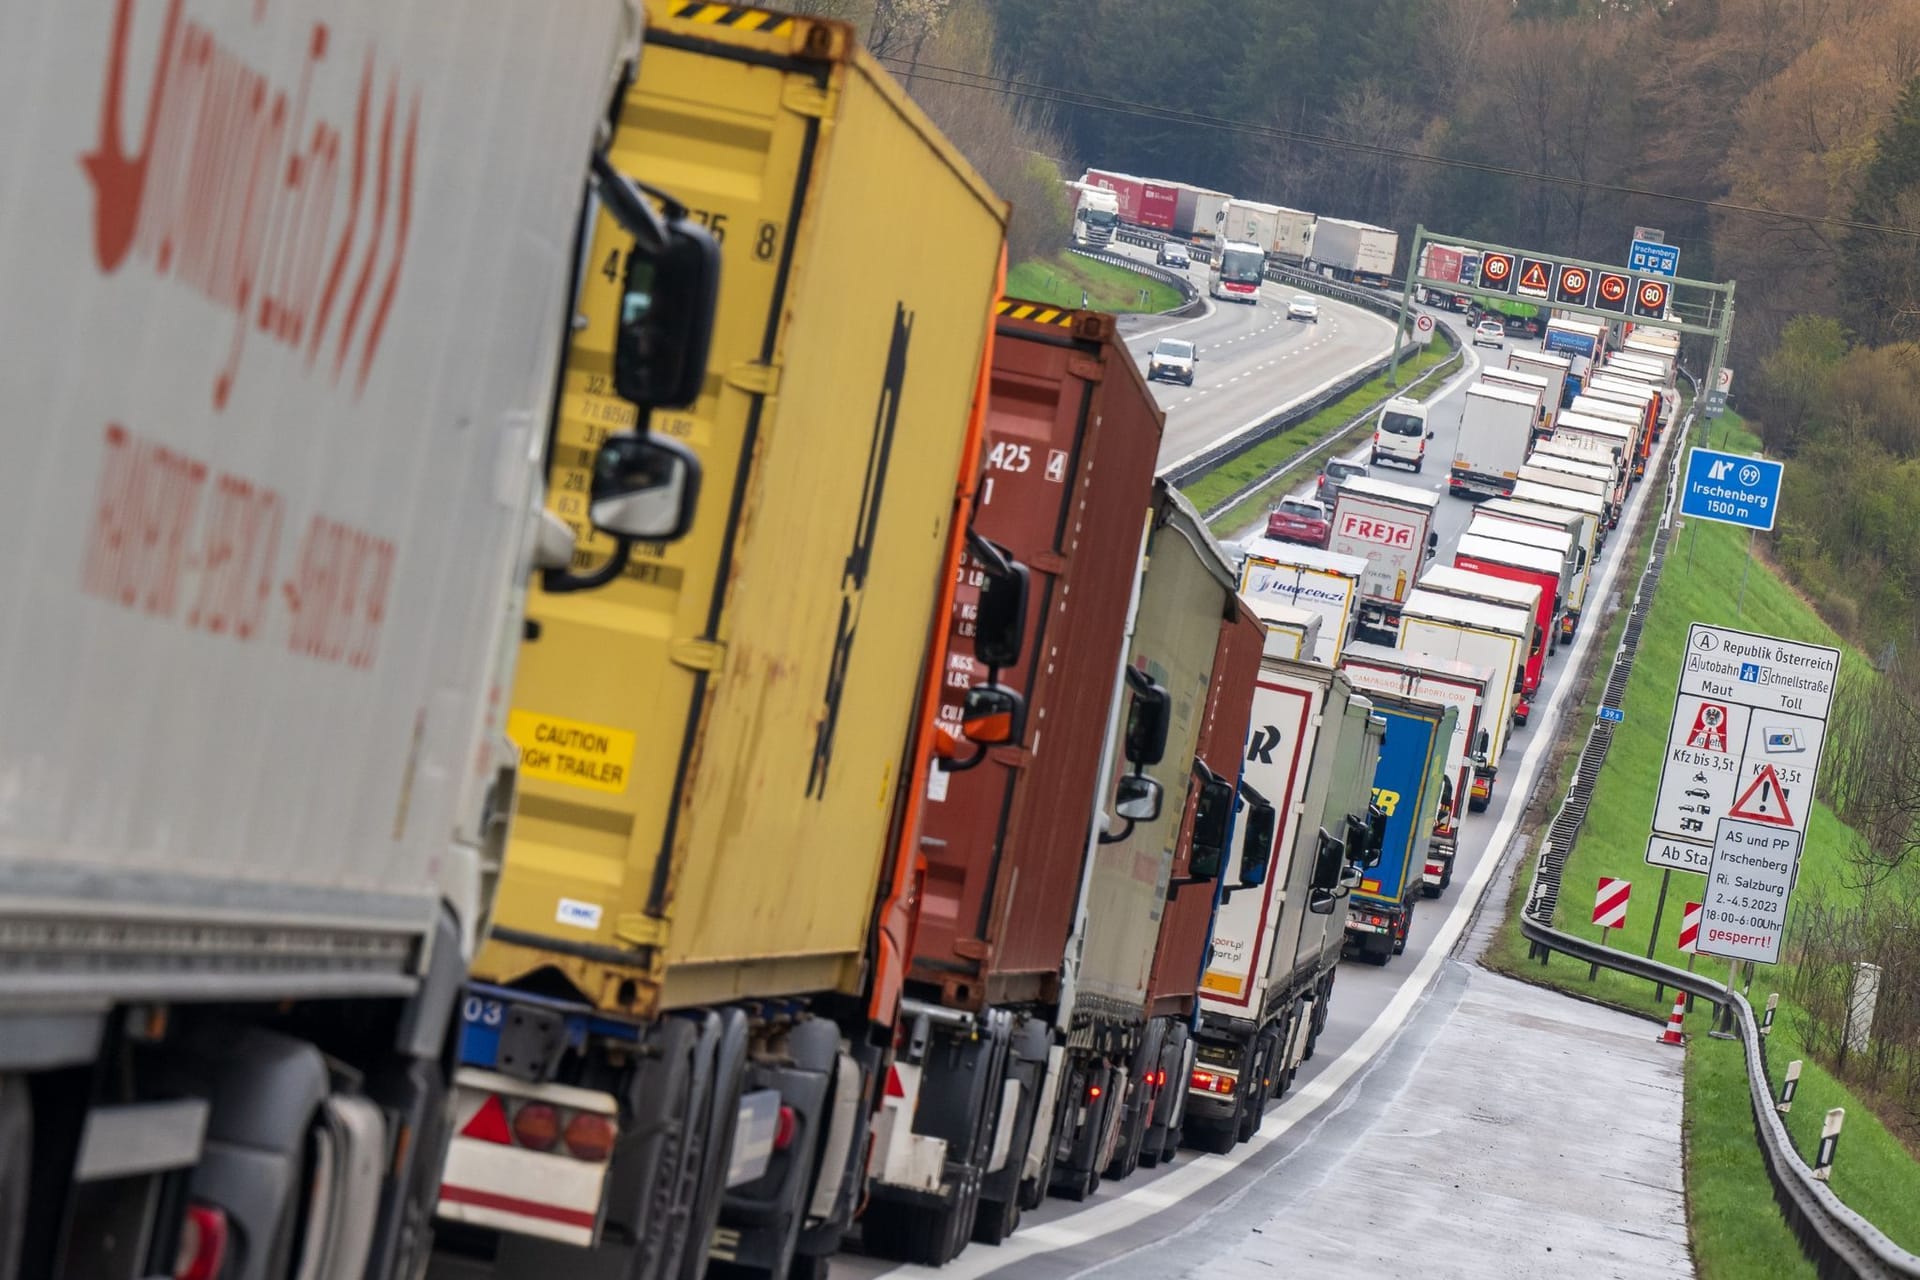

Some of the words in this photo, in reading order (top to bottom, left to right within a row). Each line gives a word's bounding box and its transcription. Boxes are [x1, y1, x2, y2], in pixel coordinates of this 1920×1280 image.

[756, 223, 776, 260] 8
[1635, 243, 1676, 260] Irschenberg
[1490, 261, 1504, 274] 80
[1567, 275, 1581, 288] 80
[1645, 288, 1659, 302] 80
[989, 441, 1031, 473] 425
[1048, 454, 1065, 481] 4
[1742, 468, 1758, 482] 99
[1692, 481, 1768, 508] Irschenberg
[1707, 500, 1735, 515] 1500
[1736, 507, 1749, 518] m
[1345, 517, 1411, 544] FREJA
[1700, 634, 1710, 649] A
[1723, 639, 1772, 660] Republik
[1775, 647, 1833, 672] Österreich
[1690, 656, 1739, 677] Autobahn
[1761, 668, 1829, 694] Schnellstraße
[1701, 680, 1734, 697] Maut
[1781, 695, 1803, 710] Toll
[534, 722, 610, 755] CAUTION
[556, 755, 624, 784] TRAILER
[1672, 748, 1690, 763] Kfz
[1693, 753, 1710, 767] bis
[1712, 756, 1735, 772] 3,5t
[1725, 831, 1743, 843] AS
[1747, 836, 1769, 848] und
[1772, 839, 1790, 850] PP
[1661, 845, 1680, 861] Ab
[1684, 849, 1711, 866] Sta
[1720, 850, 1788, 875] Irschenberg
[1716, 873, 1730, 885] Ri.
[1735, 876, 1785, 897] Salzburg
[1708, 929, 1772, 949] gesperrt!
[463, 996, 502, 1025] 03
